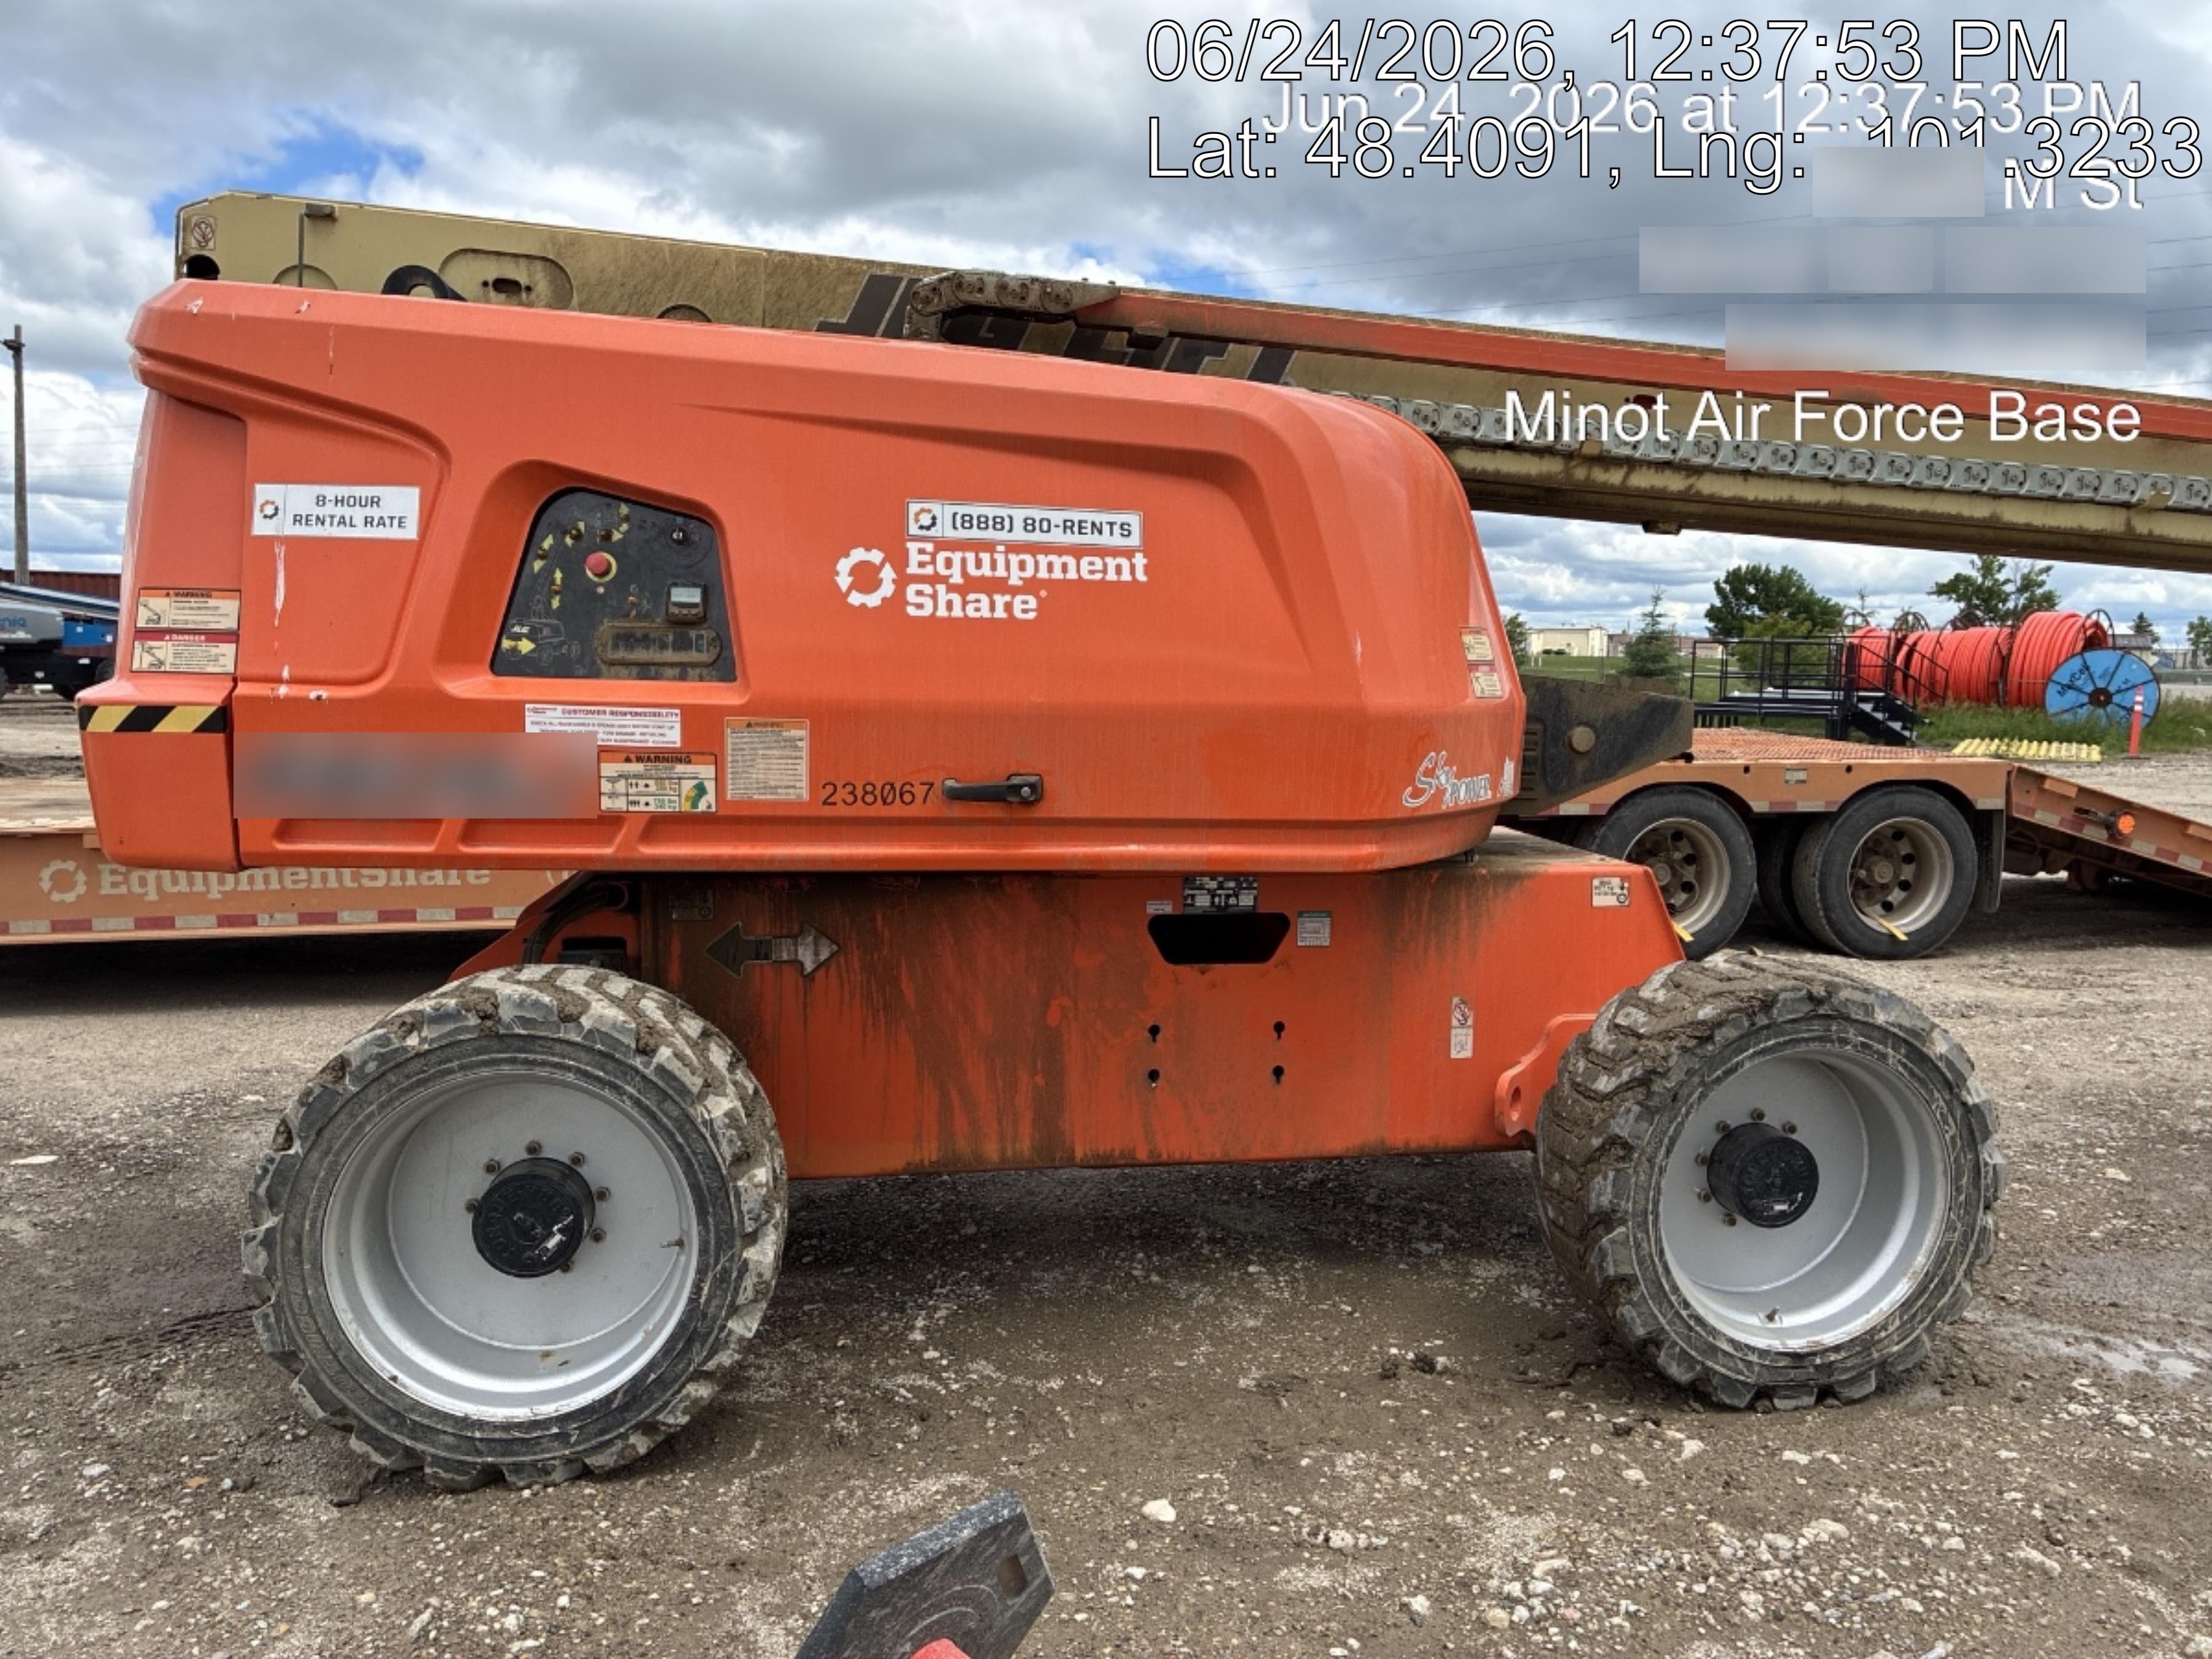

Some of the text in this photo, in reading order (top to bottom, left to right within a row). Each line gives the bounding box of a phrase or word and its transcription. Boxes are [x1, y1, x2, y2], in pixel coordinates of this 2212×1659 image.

[315, 494, 382, 509] 8-HOUR
[292, 513, 408, 530] RENTAL RATE
[951, 511, 1132, 538] (888) 80-RENTS
[906, 541, 1148, 586] Equipment
[906, 583, 1038, 620] Share
[635, 755, 692, 764] WARNING
[822, 781, 935, 806] 238067
